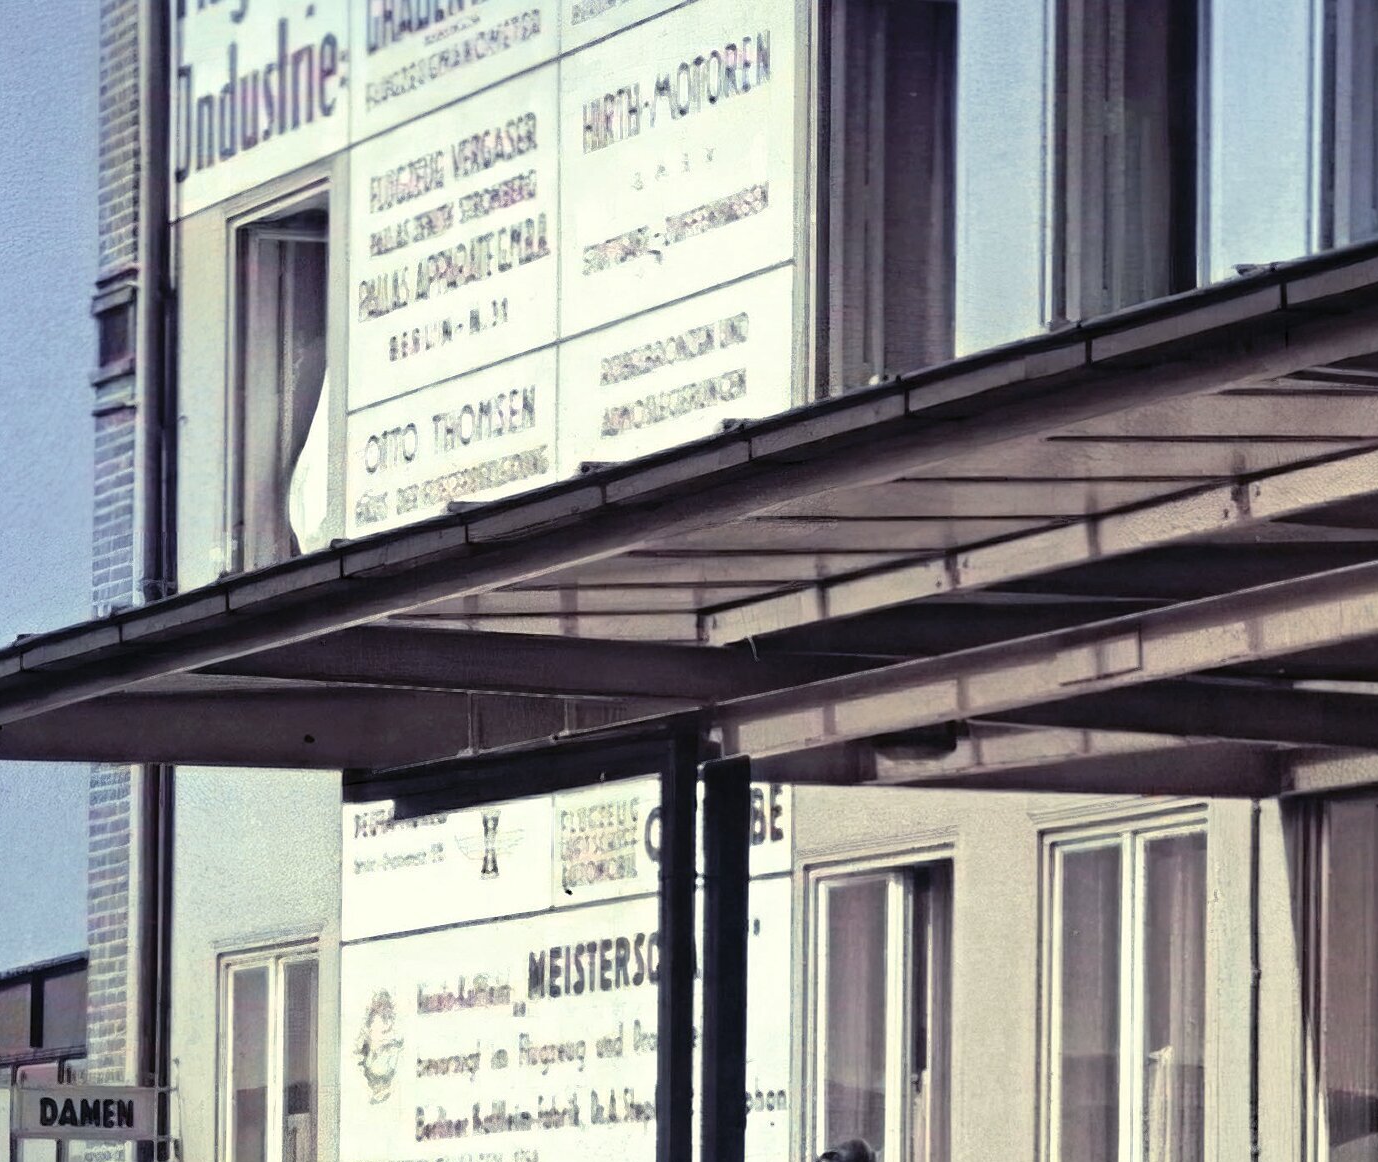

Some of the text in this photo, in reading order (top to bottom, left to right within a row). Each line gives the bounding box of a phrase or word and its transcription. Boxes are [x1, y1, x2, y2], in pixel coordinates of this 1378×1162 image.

[452, 112, 538, 180] VERGASER
[364, 384, 536, 474] OTTO THOMSEN
[39, 1096, 135, 1128] DAMEN
